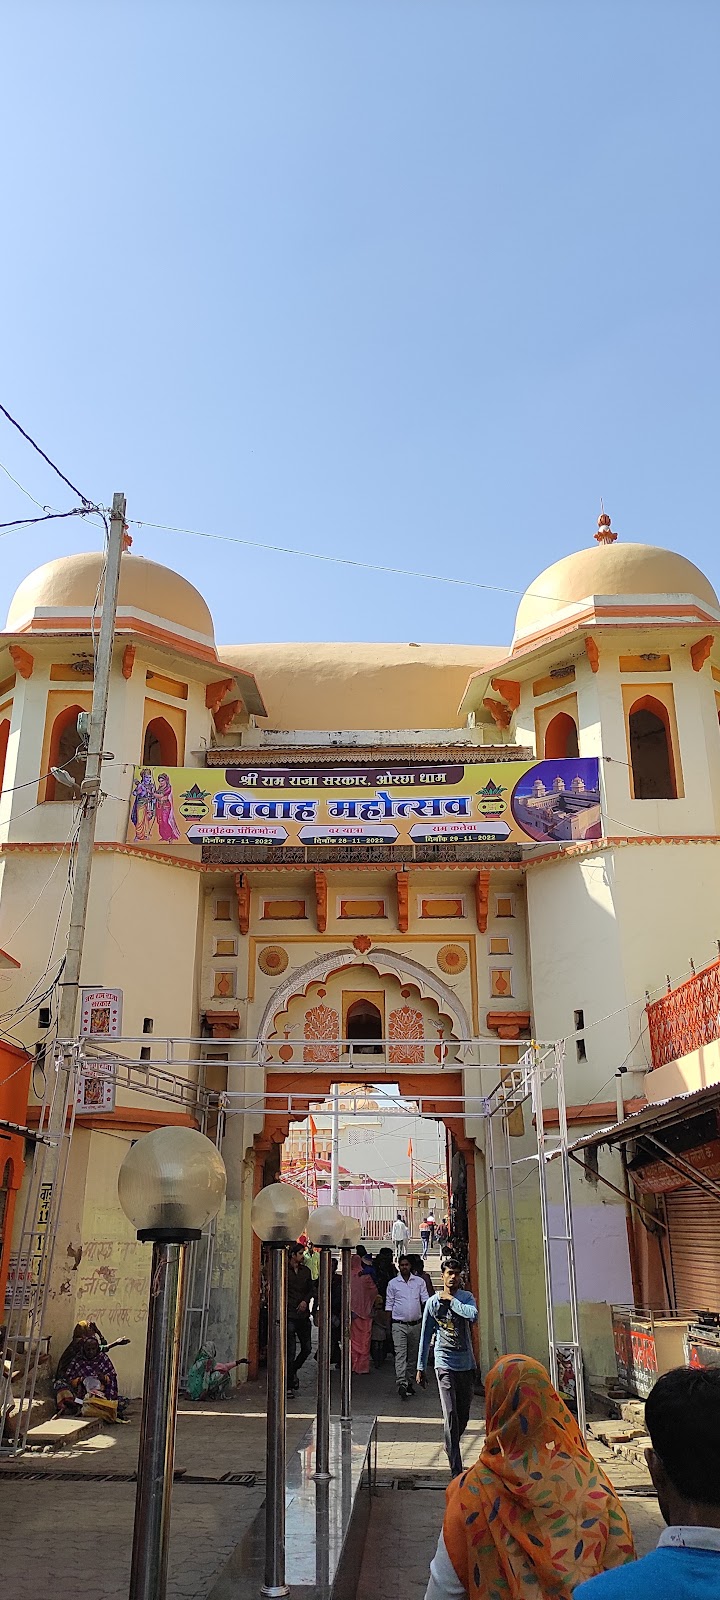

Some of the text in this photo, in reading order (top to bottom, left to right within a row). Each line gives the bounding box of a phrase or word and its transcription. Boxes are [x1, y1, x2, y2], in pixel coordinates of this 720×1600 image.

[239, 771, 446, 787] श्री राम राजा सरकार, ओरछा धाम
[212, 790, 472, 822] विवाह महोत्सव
[450, 824, 477, 832] कलेवा
